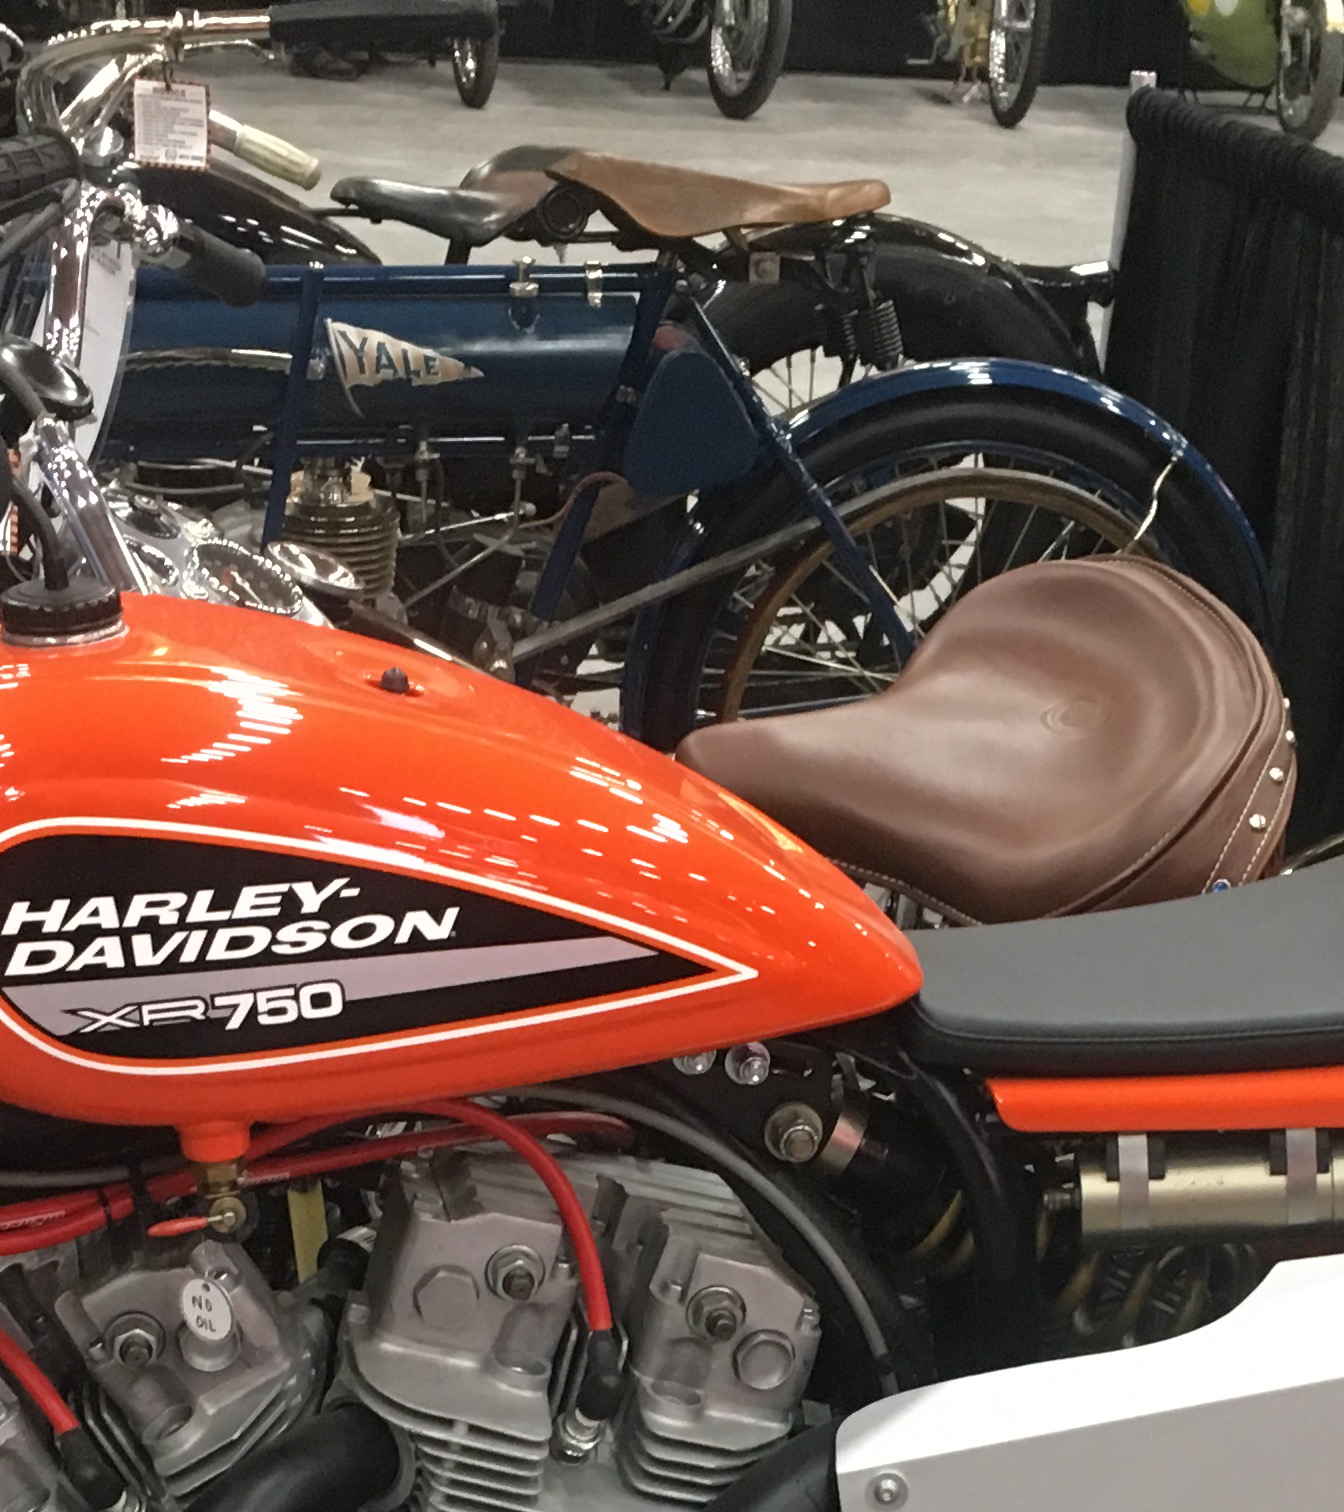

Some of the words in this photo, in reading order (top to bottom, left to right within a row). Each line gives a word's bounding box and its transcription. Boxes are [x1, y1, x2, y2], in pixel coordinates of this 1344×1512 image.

[337, 330, 438, 378] YALE
[1, 877, 361, 936] HARLEY-
[4, 907, 460, 977] DAVIDSON
[64, 977, 346, 1033] XR750
[191, 1295, 213, 1312] NO
[195, 1315, 216, 1333] OIL
